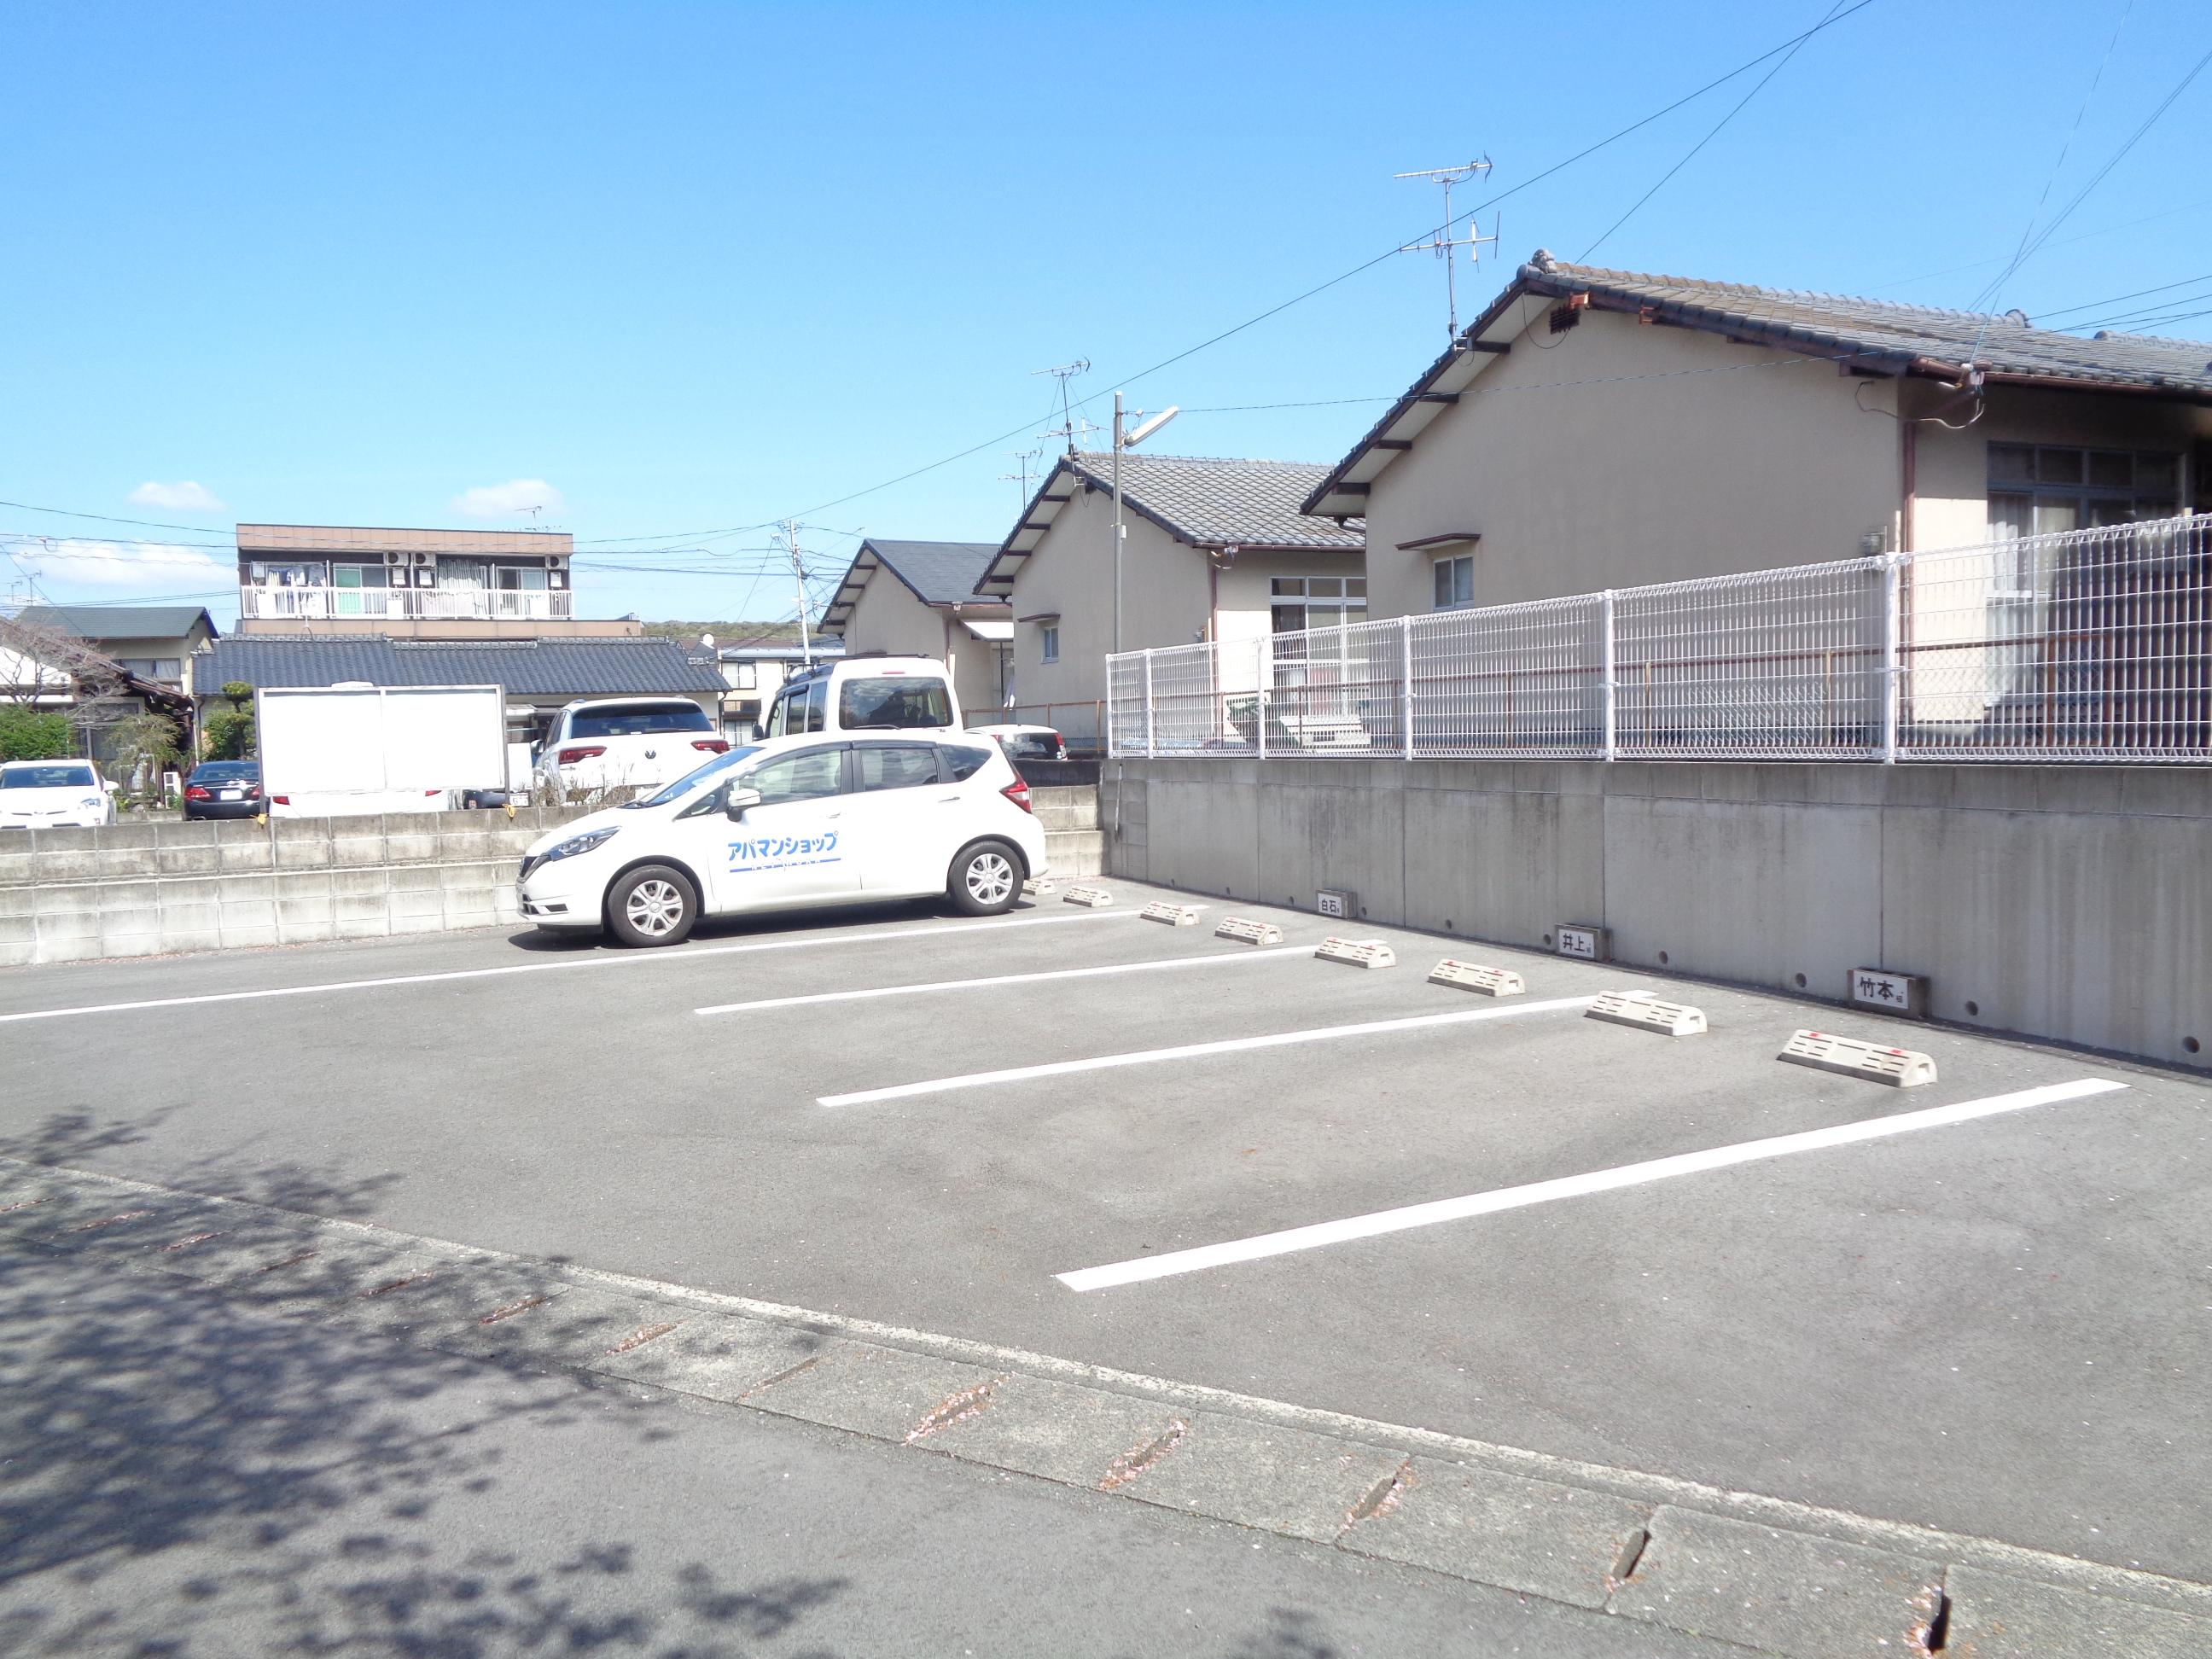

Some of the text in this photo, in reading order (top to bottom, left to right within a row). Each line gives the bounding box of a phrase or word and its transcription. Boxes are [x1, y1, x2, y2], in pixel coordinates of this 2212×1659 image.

[727, 830, 839, 861] アパマンショップ
[1563, 933, 1585, 952] 井上
[1860, 976, 1894, 1000] 竹本
